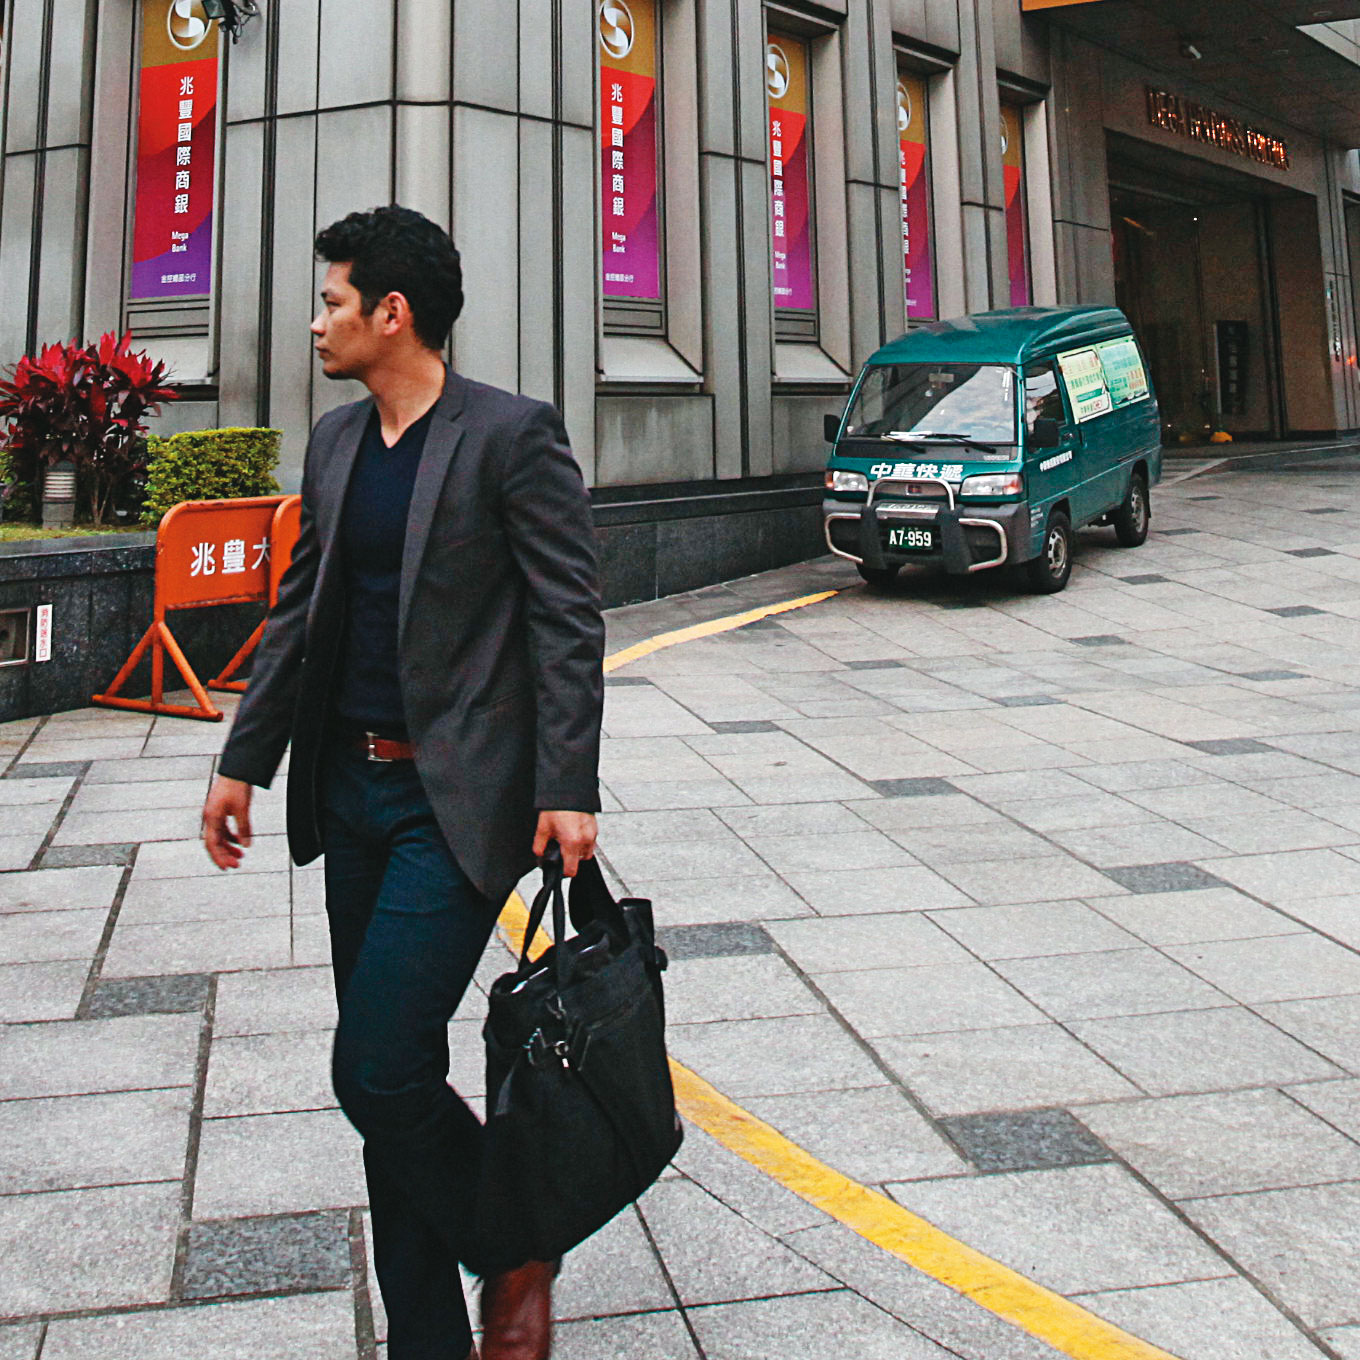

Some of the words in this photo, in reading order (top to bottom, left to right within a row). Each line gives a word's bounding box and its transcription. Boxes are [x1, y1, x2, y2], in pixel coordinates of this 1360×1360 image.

[174, 76, 195, 214] 兆豐國際商銀
[889, 529, 932, 548] A7-959
